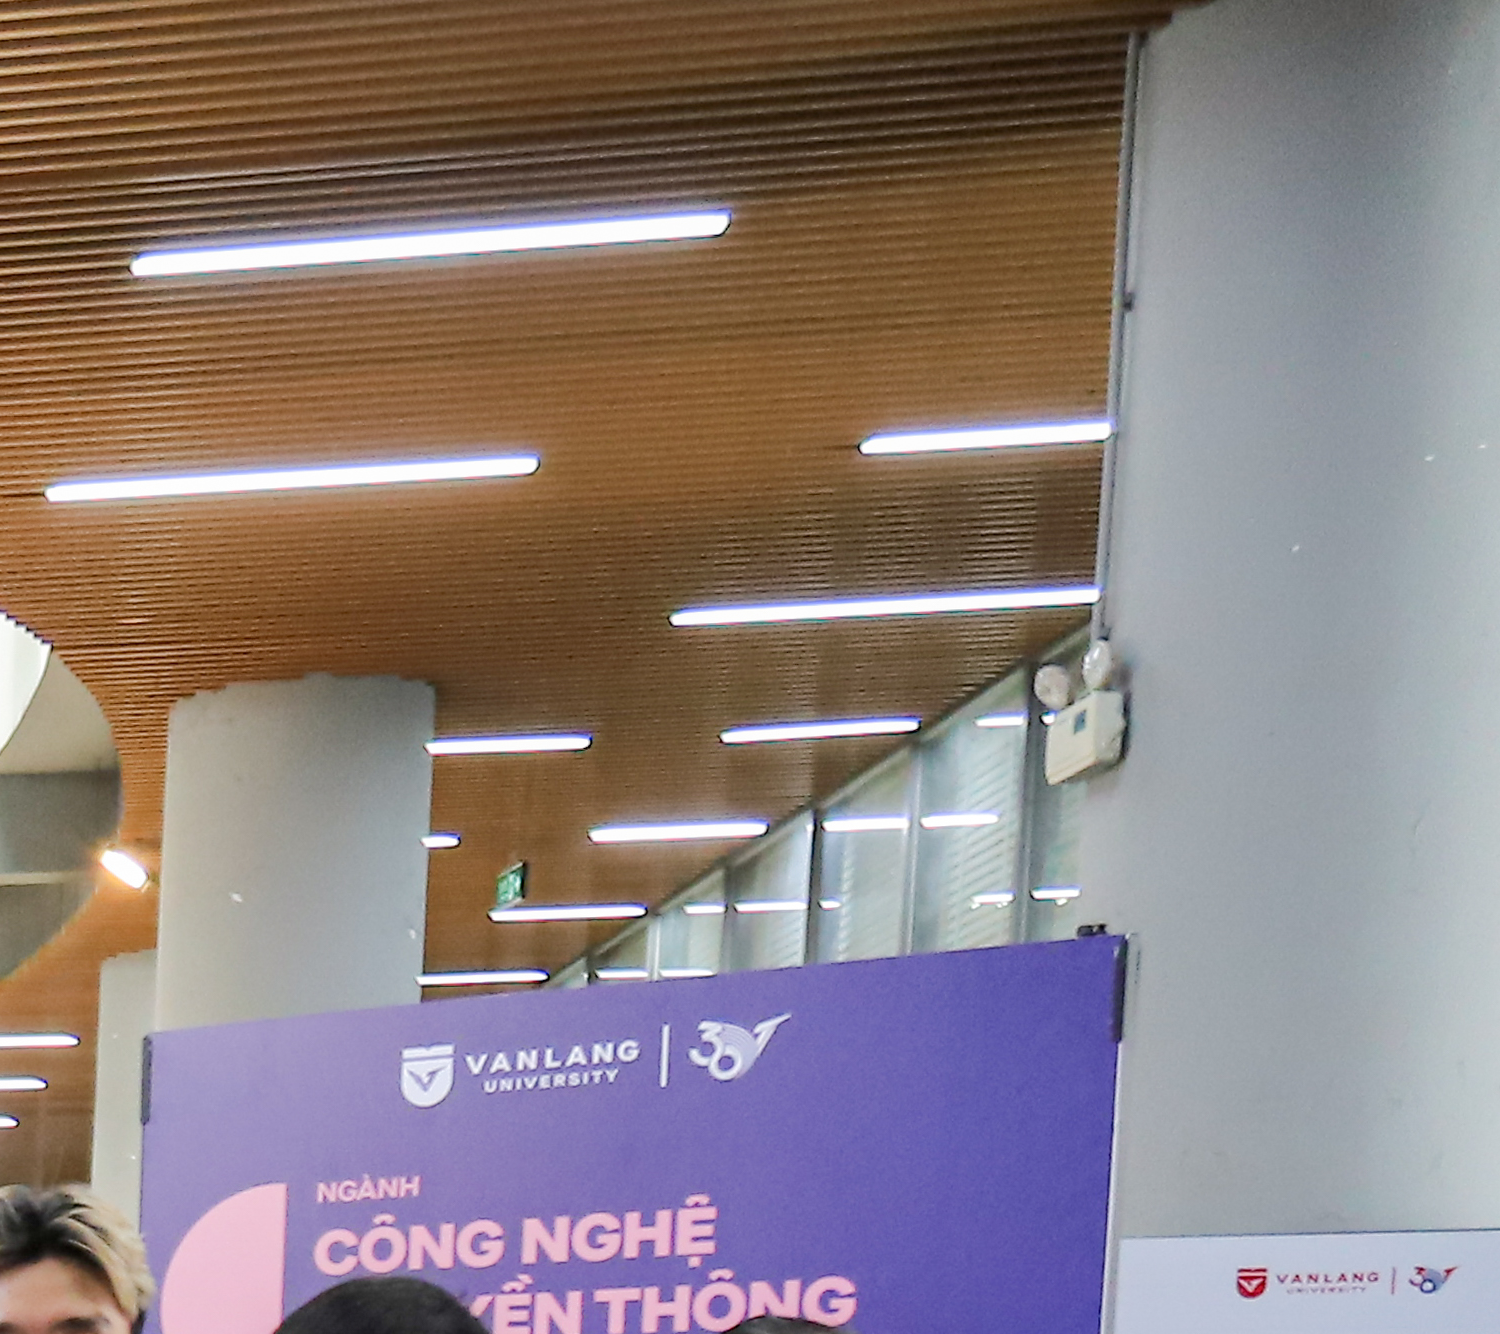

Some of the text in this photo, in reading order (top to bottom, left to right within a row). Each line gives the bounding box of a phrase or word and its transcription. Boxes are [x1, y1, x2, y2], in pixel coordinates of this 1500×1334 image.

[464, 1039, 640, 1075] VANLANG
[482, 1069, 620, 1095] UNIVERSITY
[316, 1175, 421, 1203] NGÀNH
[313, 1195, 718, 1276] CÔNG NGHỆ
[1276, 1271, 1380, 1285] VANLANG
[594, 1269, 857, 1334] THÔNG
